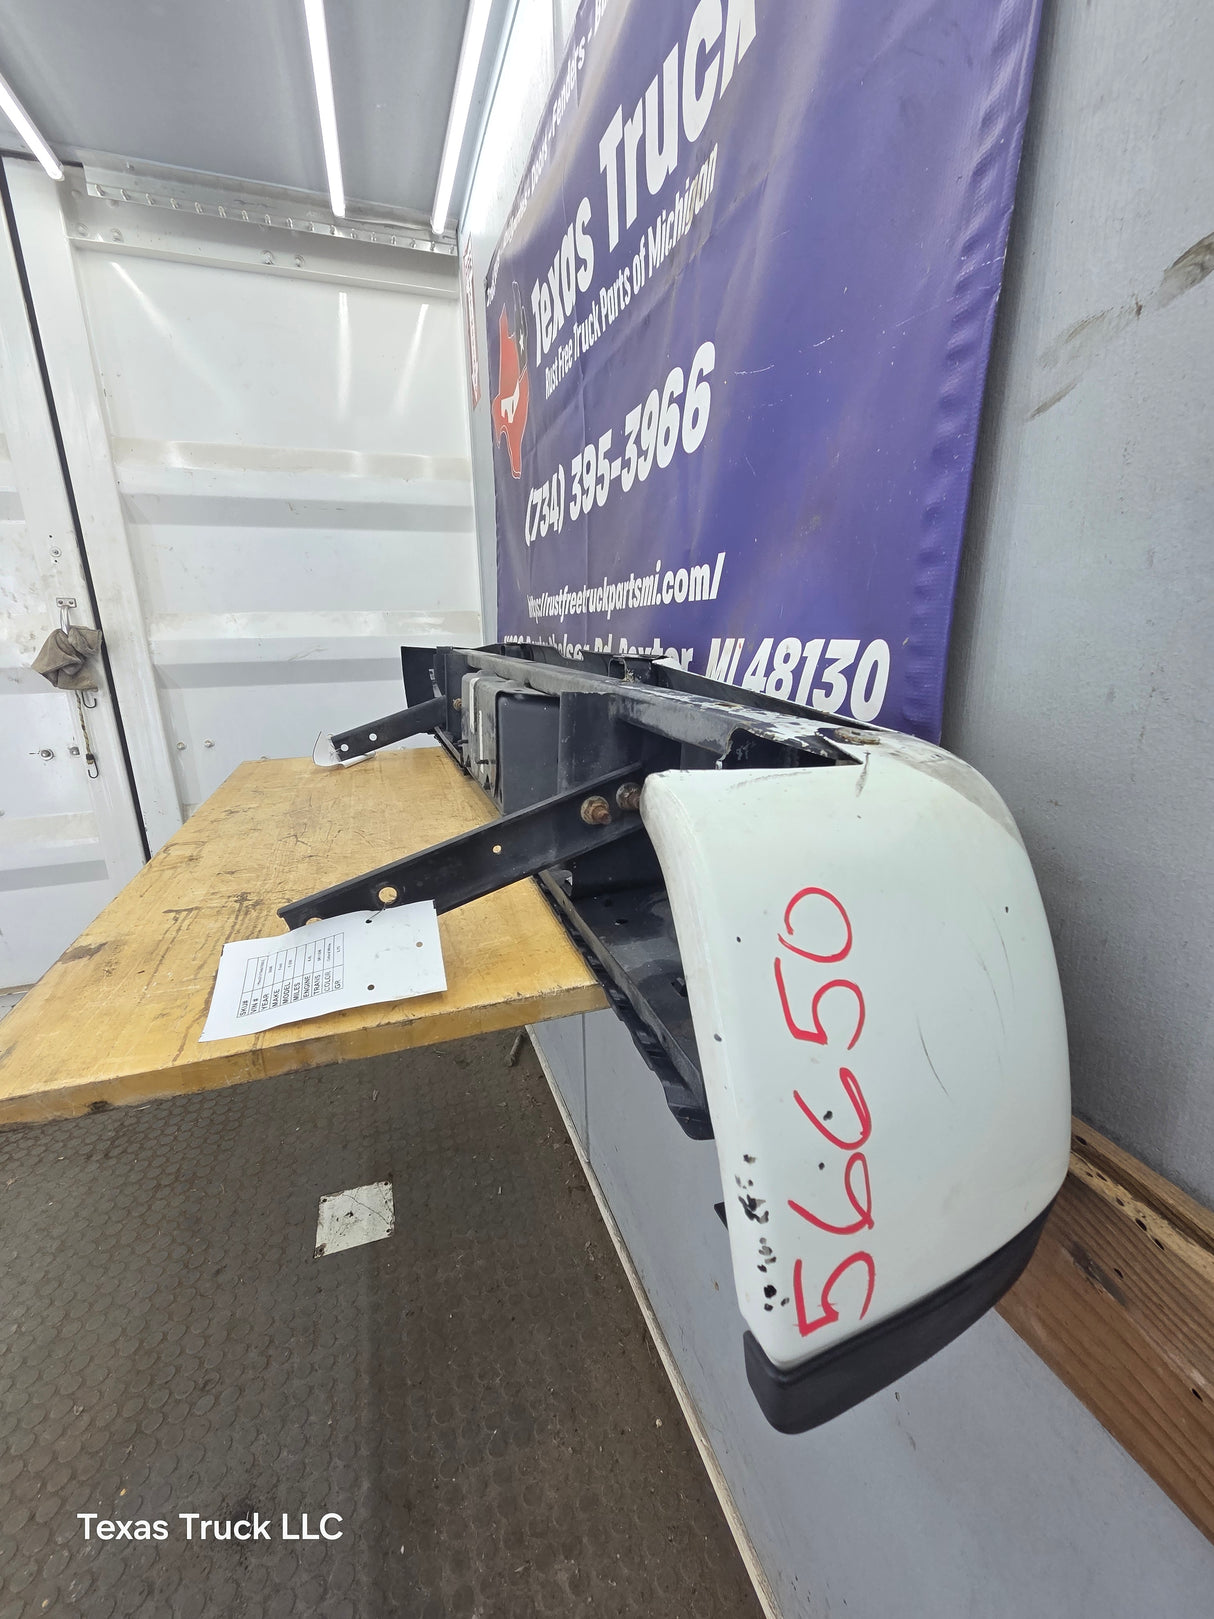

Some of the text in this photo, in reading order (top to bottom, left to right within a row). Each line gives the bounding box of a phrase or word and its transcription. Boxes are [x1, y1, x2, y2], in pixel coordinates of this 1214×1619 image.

[551, 36, 586, 138] Fenders
[530, 196, 595, 368] Texas
[545, 142, 718, 400] Rust Free Truck Parts of Michigan
[524, 341, 716, 547] (734) 395-3966
[741, 637, 891, 723] 48130
[293, 982, 301, 1001] MILES
[303, 975, 311, 998] ENGINE
[313, 974, 321, 995] TRANS
[323, 970, 332, 992] COLOR
[261, 992, 270, 1011] YEAR
[271, 988, 280, 1008] MAKE
[282, 982, 291, 1005] MODEL
[239, 999, 249, 1017] SKU#
